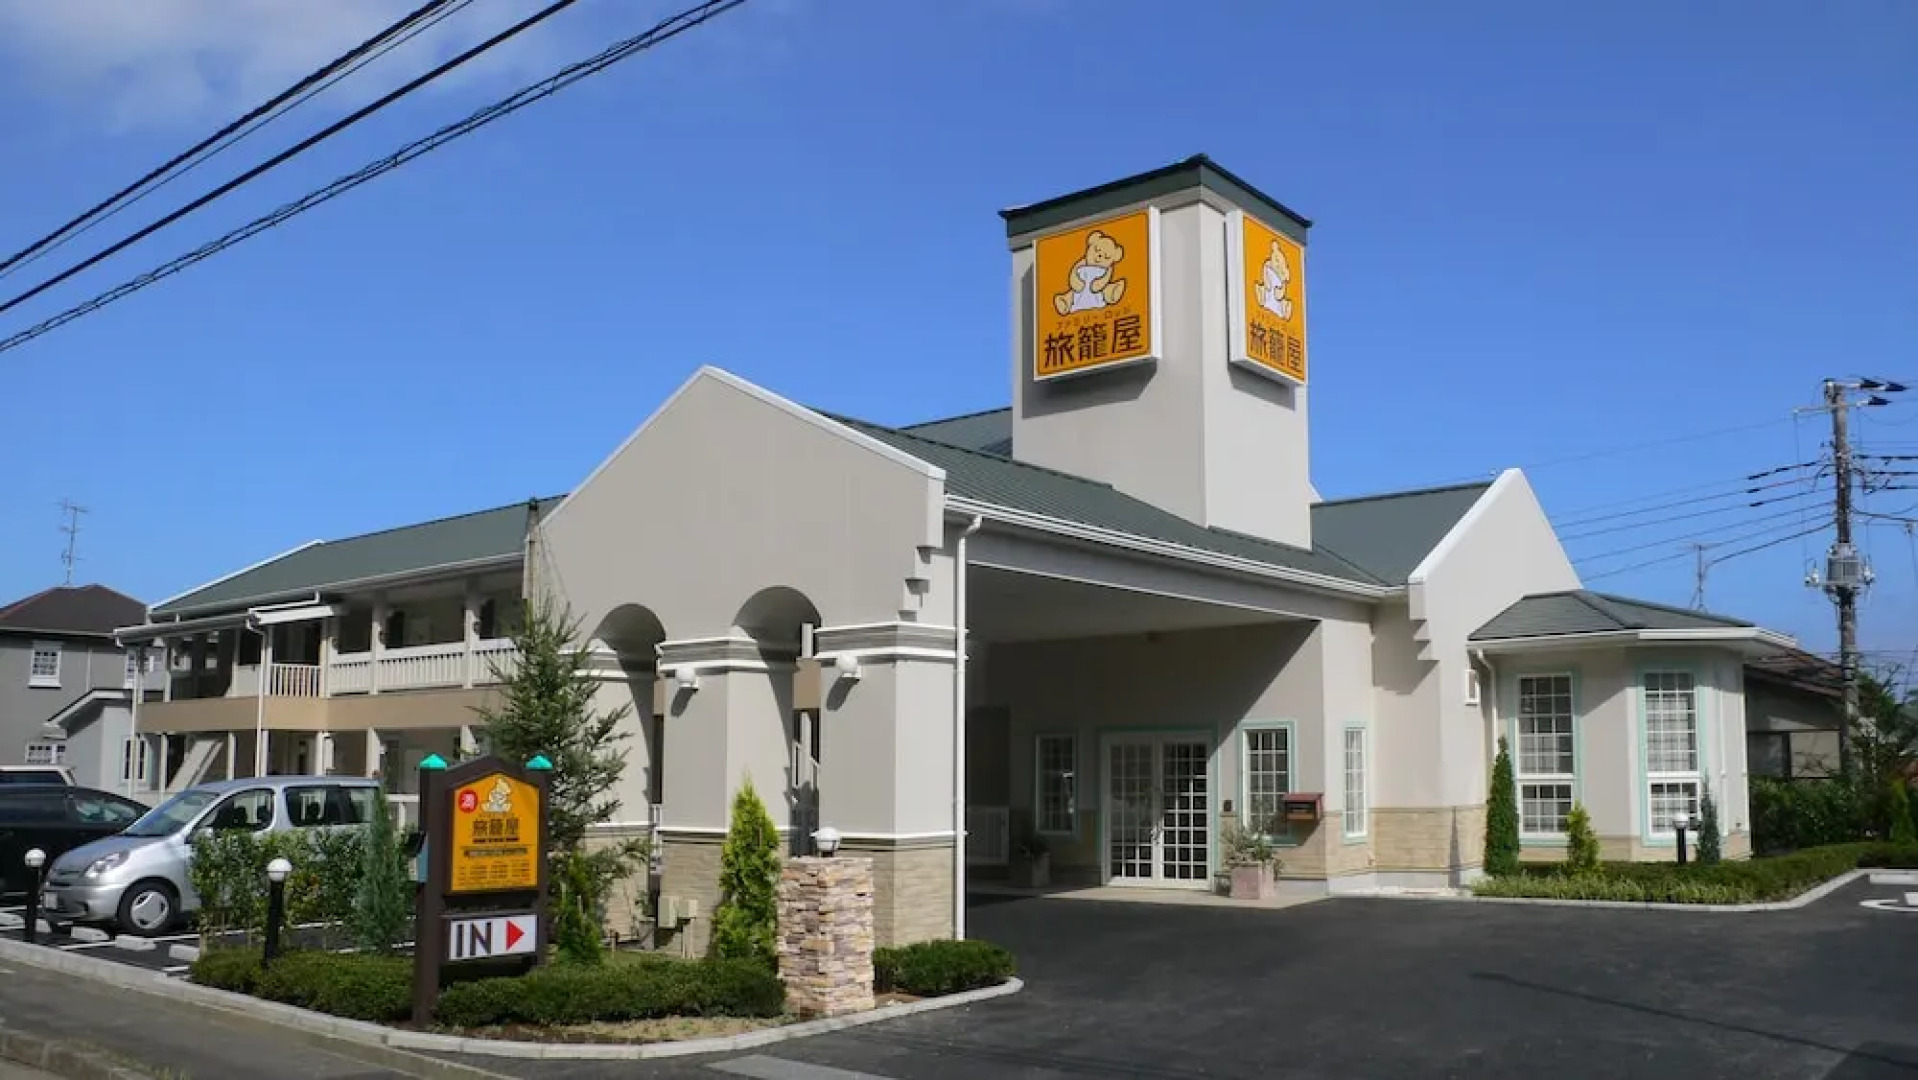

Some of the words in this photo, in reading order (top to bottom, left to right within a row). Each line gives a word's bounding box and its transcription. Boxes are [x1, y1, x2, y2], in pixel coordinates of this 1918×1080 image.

[1044, 315, 1142, 368] 旅籠屋
[1249, 319, 1302, 373] 旅籠屋
[456, 922, 492, 958] IN
